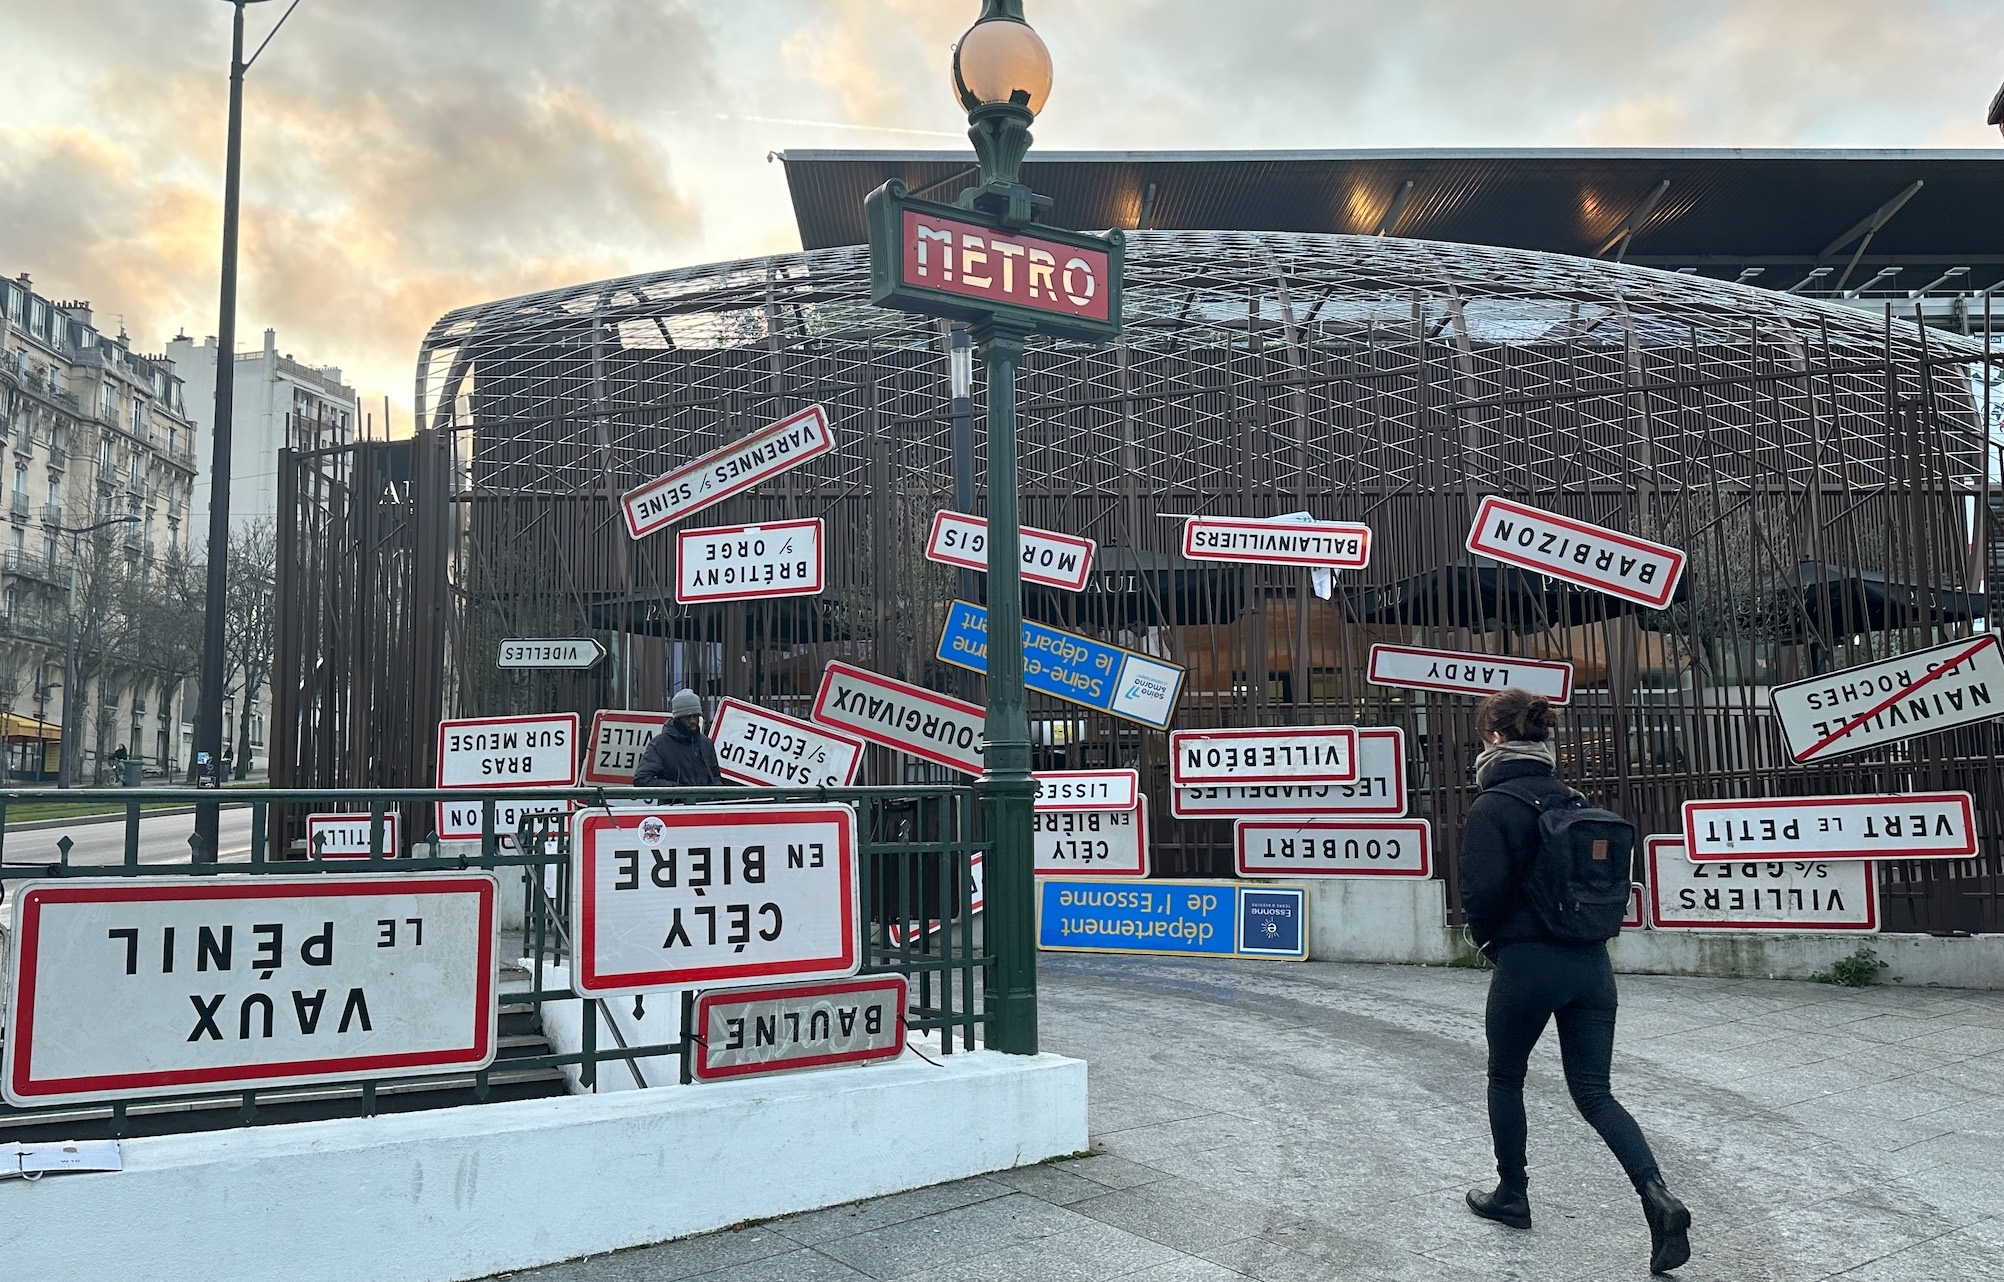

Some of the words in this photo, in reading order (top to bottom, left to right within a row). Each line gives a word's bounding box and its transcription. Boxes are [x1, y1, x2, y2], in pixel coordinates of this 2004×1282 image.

[917, 224, 1096, 306] METRO
[715, 425, 815, 484] VARENNES
[637, 482, 692, 520] SEINE
[706, 539, 766, 561] ORGE
[944, 528, 1077, 573] MORGIS
[1195, 531, 1358, 555] BALLAINVILLIERS
[1494, 518, 1657, 585] BARBIZON
[692, 561, 807, 587] BRÉTIGNY
[1087, 575, 1142, 594] AUL
[505, 647, 577, 660] VIDELLES
[1095, 652, 1114, 677] le
[1428, 661, 1510, 686] LARDY
[1806, 669, 1912, 710] ROCHES
[1813, 682, 1991, 743] NAINVILLE
[450, 732, 517, 752] MEUSE
[526, 730, 565, 748] SUR
[744, 722, 807, 760] ÉCOLE
[482, 756, 532, 775] BRAS
[720, 741, 812, 785] SAUVEUR
[1188, 745, 1340, 772] VILLEBÉON
[1034, 783, 1108, 799] LISSES
[1342, 777, 1387, 798] LES
[1034, 813, 1100, 836] BIÈRE
[1110, 812, 1130, 826] EN
[1705, 818, 1800, 842] PETIT
[1818, 816, 1843, 832] LE
[1864, 814, 1953, 838] VERT
[787, 843, 824, 869] EN
[1052, 840, 1109, 864] CÉLY
[1264, 838, 1401, 860] COUBERT
[614, 845, 765, 896] BIÈRE
[1187, 893, 1217, 915] de
[1679, 888, 1845, 911] VILLIERS
[1251, 908, 1292, 918] Essonne
[377, 917, 423, 948] LE
[662, 902, 783, 953] CÉLY
[1061, 917, 1214, 945] département
[108, 921, 334, 980] PÉNIL
[186, 987, 372, 1042] VAUX
[725, 1004, 882, 1050] BAULNE
